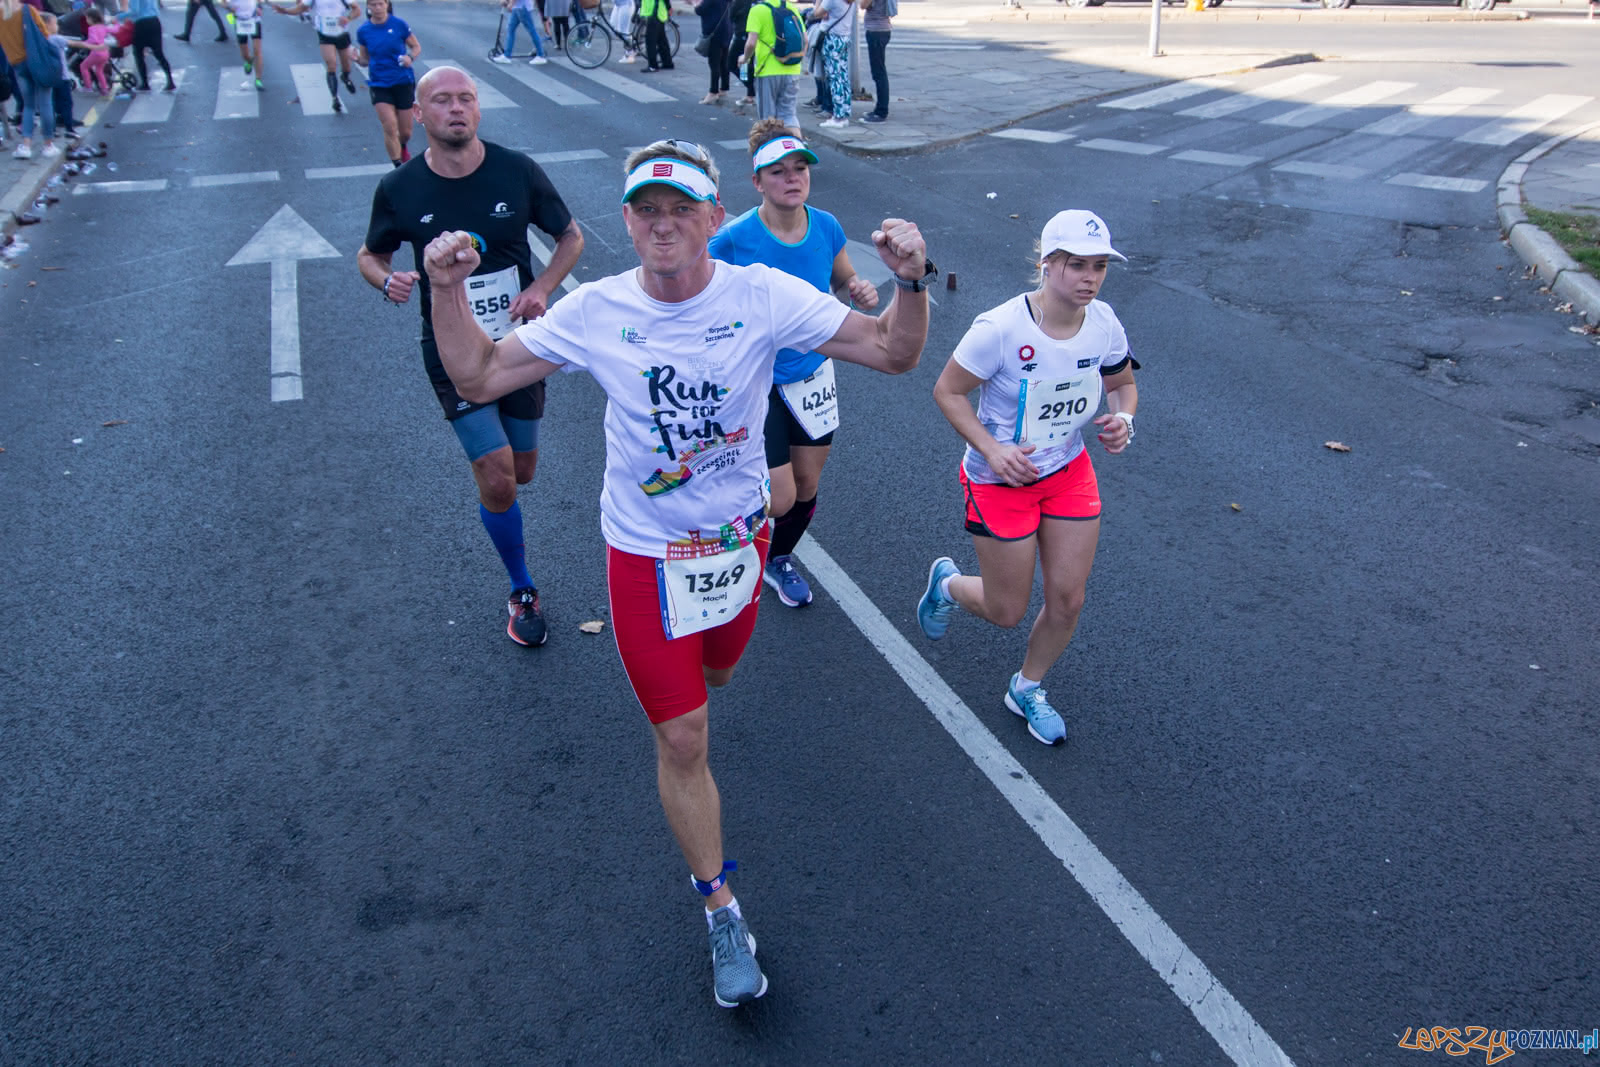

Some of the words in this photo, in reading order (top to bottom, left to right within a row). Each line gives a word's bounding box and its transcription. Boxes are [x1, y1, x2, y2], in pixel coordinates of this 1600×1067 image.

[469, 294, 510, 316] 558
[708, 325, 730, 334] Torpedo
[705, 332, 735, 343] Szczecinek
[1021, 363, 1038, 372] 4F
[649, 365, 723, 411] Run
[691, 405, 721, 419] for
[1038, 397, 1087, 420] 2910
[650, 410, 726, 461] Fun
[715, 457, 736, 471] 2018
[685, 564, 745, 593] 1349
[702, 592, 728, 603] Maciej
